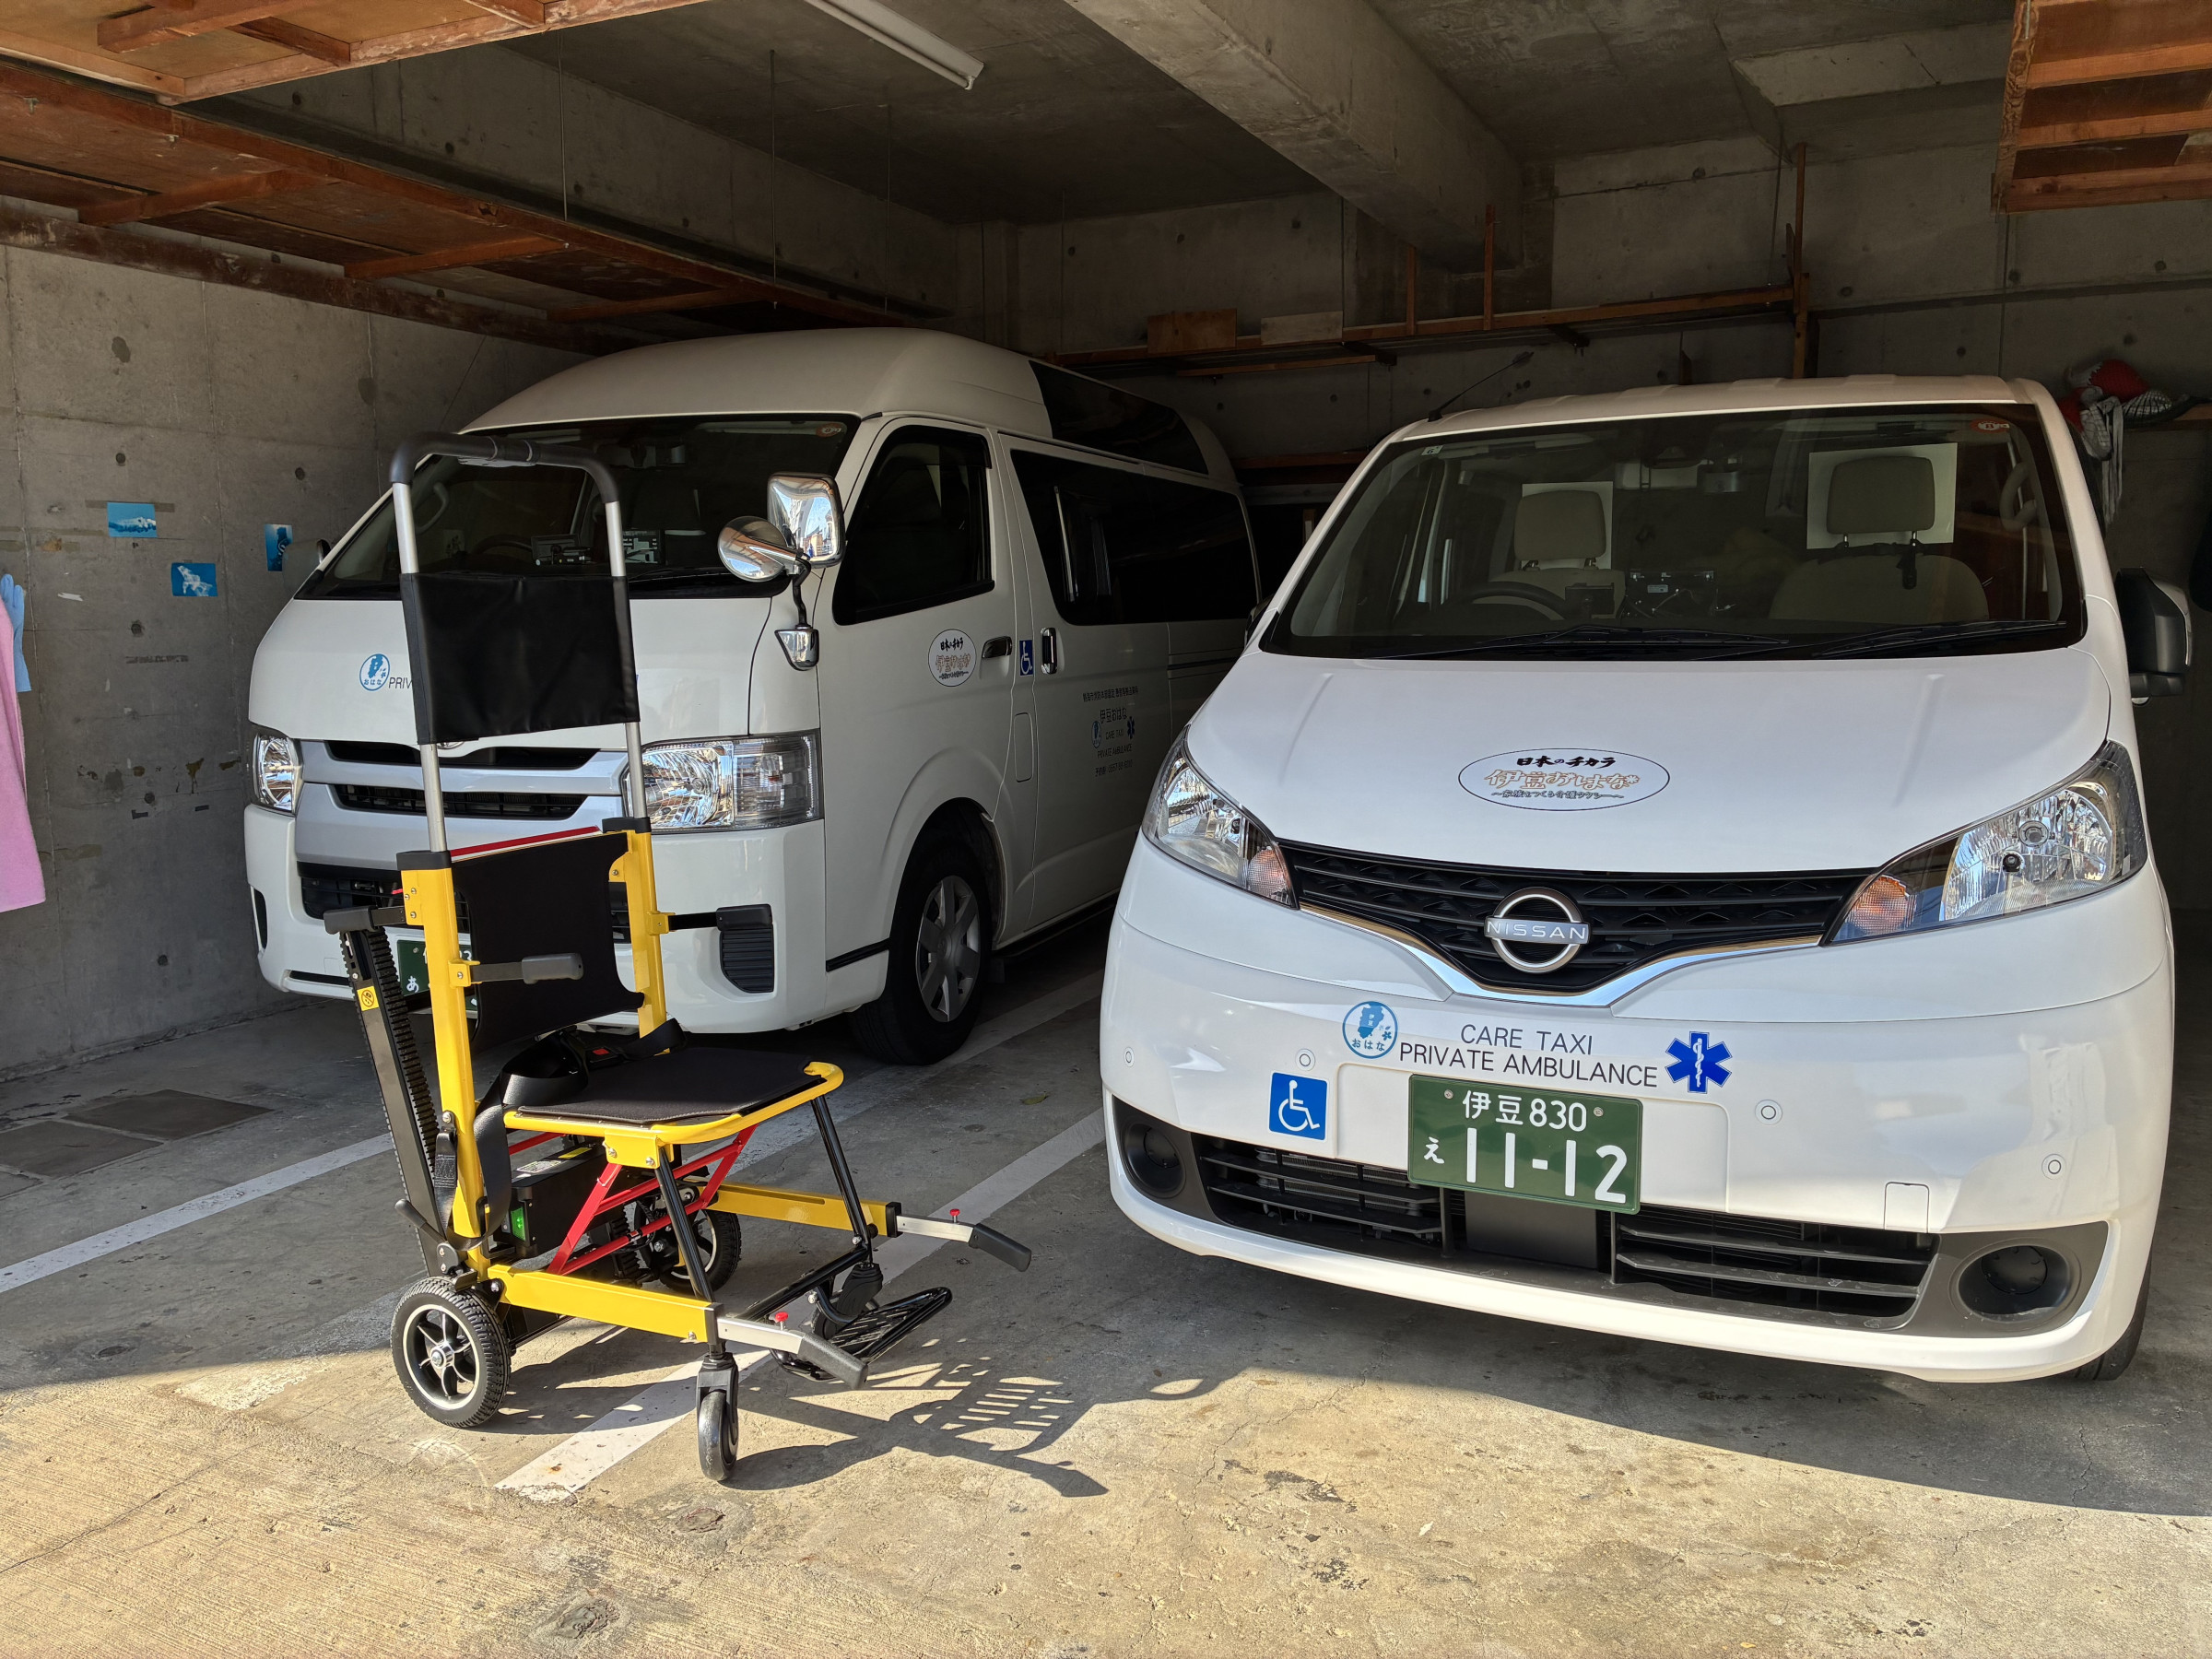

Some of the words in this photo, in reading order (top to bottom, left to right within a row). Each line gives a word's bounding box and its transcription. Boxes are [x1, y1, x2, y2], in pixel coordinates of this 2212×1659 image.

[389, 677, 412, 689] PRIV
[1516, 756, 1617, 769] 日本のチカラ
[1487, 922, 1586, 939] NISSAN
[406, 975, 419, 993] あ
[1351, 1038, 1385, 1052] おはな
[1460, 1024, 1523, 1050] CARE
[1536, 1030, 1593, 1055] TAXI
[1400, 1041, 1495, 1072] PRIVATE
[1503, 1055, 1658, 1088] AMBULANCE
[1423, 1136, 1444, 1164] え
[1466, 1127, 1628, 1204] 11-12
